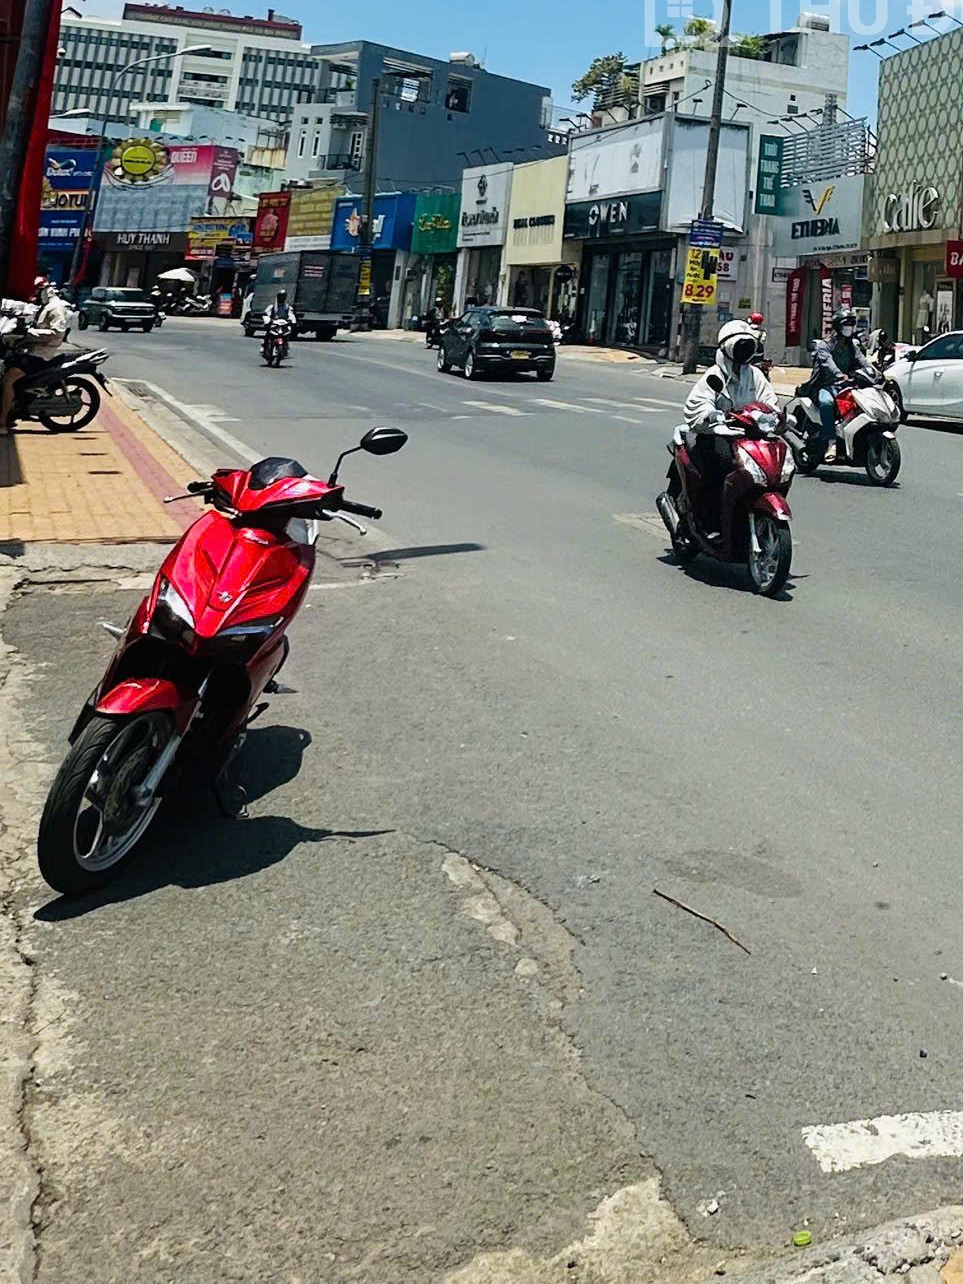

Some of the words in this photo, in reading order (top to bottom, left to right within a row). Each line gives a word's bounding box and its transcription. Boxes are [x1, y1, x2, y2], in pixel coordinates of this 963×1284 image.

[588, 201, 629, 226] OWEN
[117, 234, 137, 244] HUY
[138, 234, 170, 244] THANH
